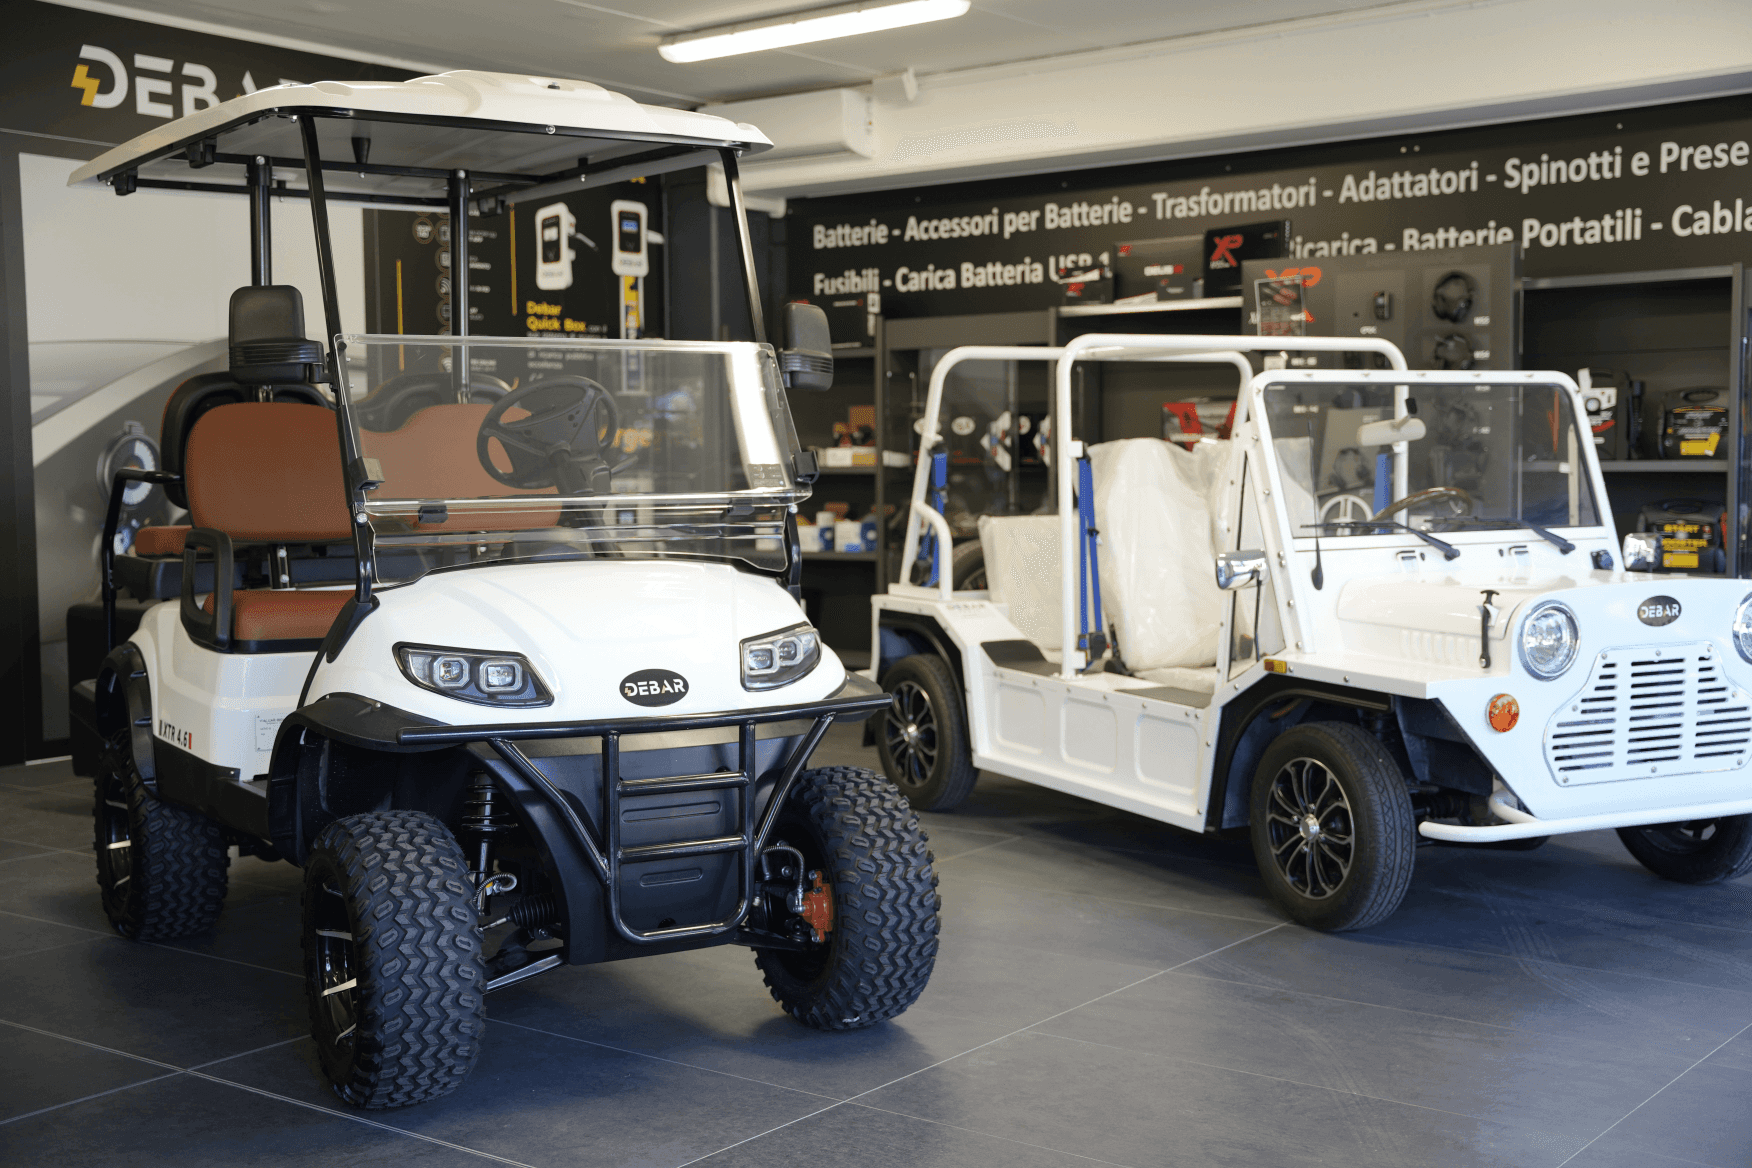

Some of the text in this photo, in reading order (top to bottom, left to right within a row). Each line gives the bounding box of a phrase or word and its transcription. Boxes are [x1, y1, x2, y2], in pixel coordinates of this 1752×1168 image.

[71, 44, 308, 118] DEB
[813, 218, 889, 249] Batterie
[904, 207, 999, 242] Accessori
[1004, 209, 1040, 239] per
[1044, 196, 1133, 230] Batterie
[1151, 177, 1316, 220] Trasformatori
[1339, 160, 1479, 204] Adattatori
[1503, 146, 1622, 194] Spinotti
[1630, 151, 1650, 176] e
[1659, 140, 1750, 173] Prese
[813, 267, 880, 295] Fusibili
[895, 263, 956, 293] Carica
[960, 256, 1044, 288] Batteria
[1290, 232, 1378, 259] icarica
[1403, 219, 1514, 251] Batterie
[1522, 208, 1643, 248] Portatili
[526, 300, 562, 316] Debar
[526, 315, 561, 331] Quick
[564, 317, 586, 332] Box
[1640, 603, 1680, 619] DEBAR
[624, 678, 686, 697] DEBAR
[162, 722, 188, 748] XTR 4.6
